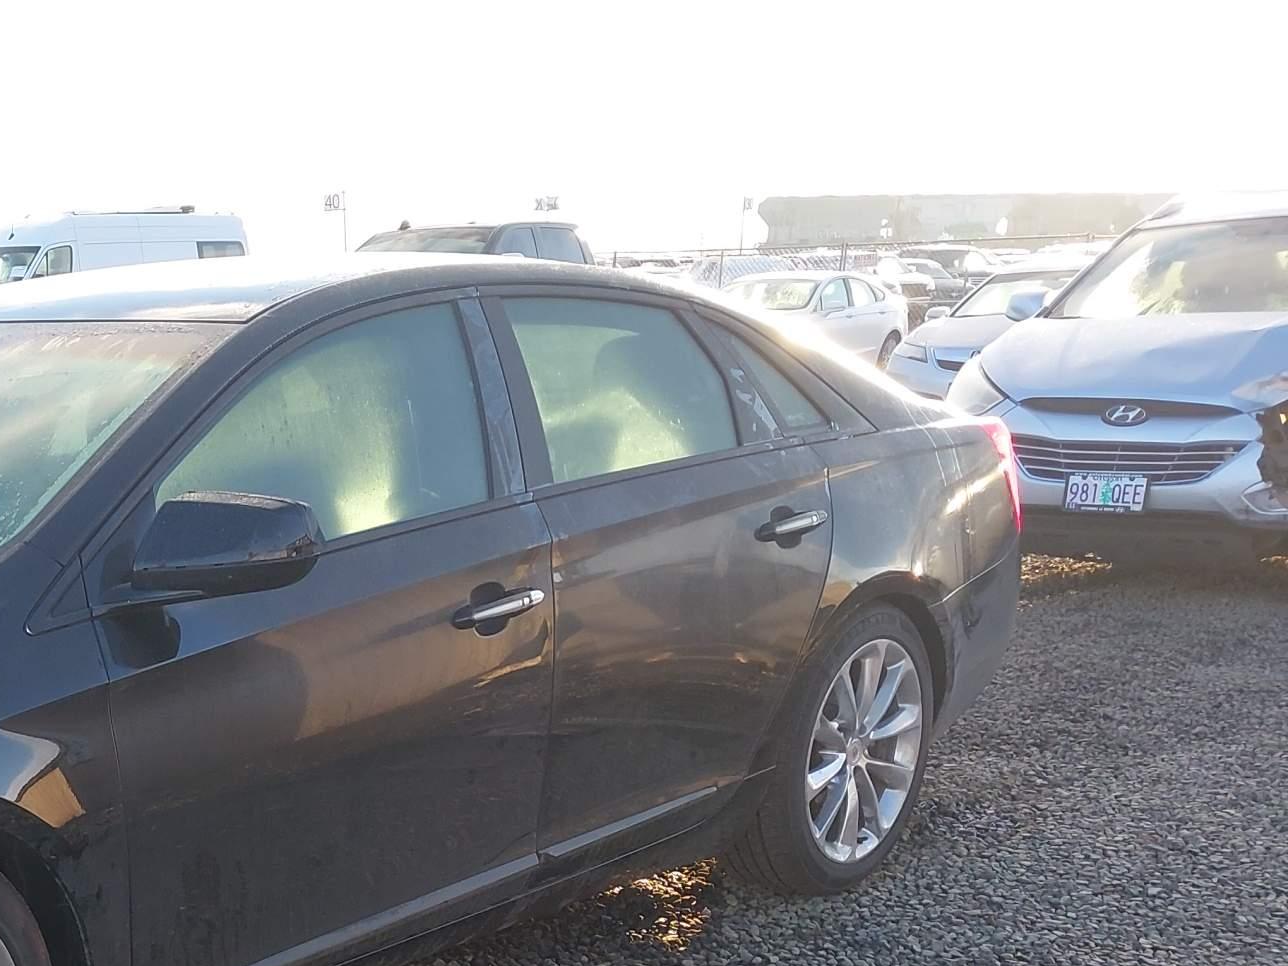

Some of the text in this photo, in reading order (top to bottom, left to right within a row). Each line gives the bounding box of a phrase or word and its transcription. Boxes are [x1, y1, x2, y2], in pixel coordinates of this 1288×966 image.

[324, 193, 340, 209] 40
[1069, 483, 1144, 504] 981 QEE
